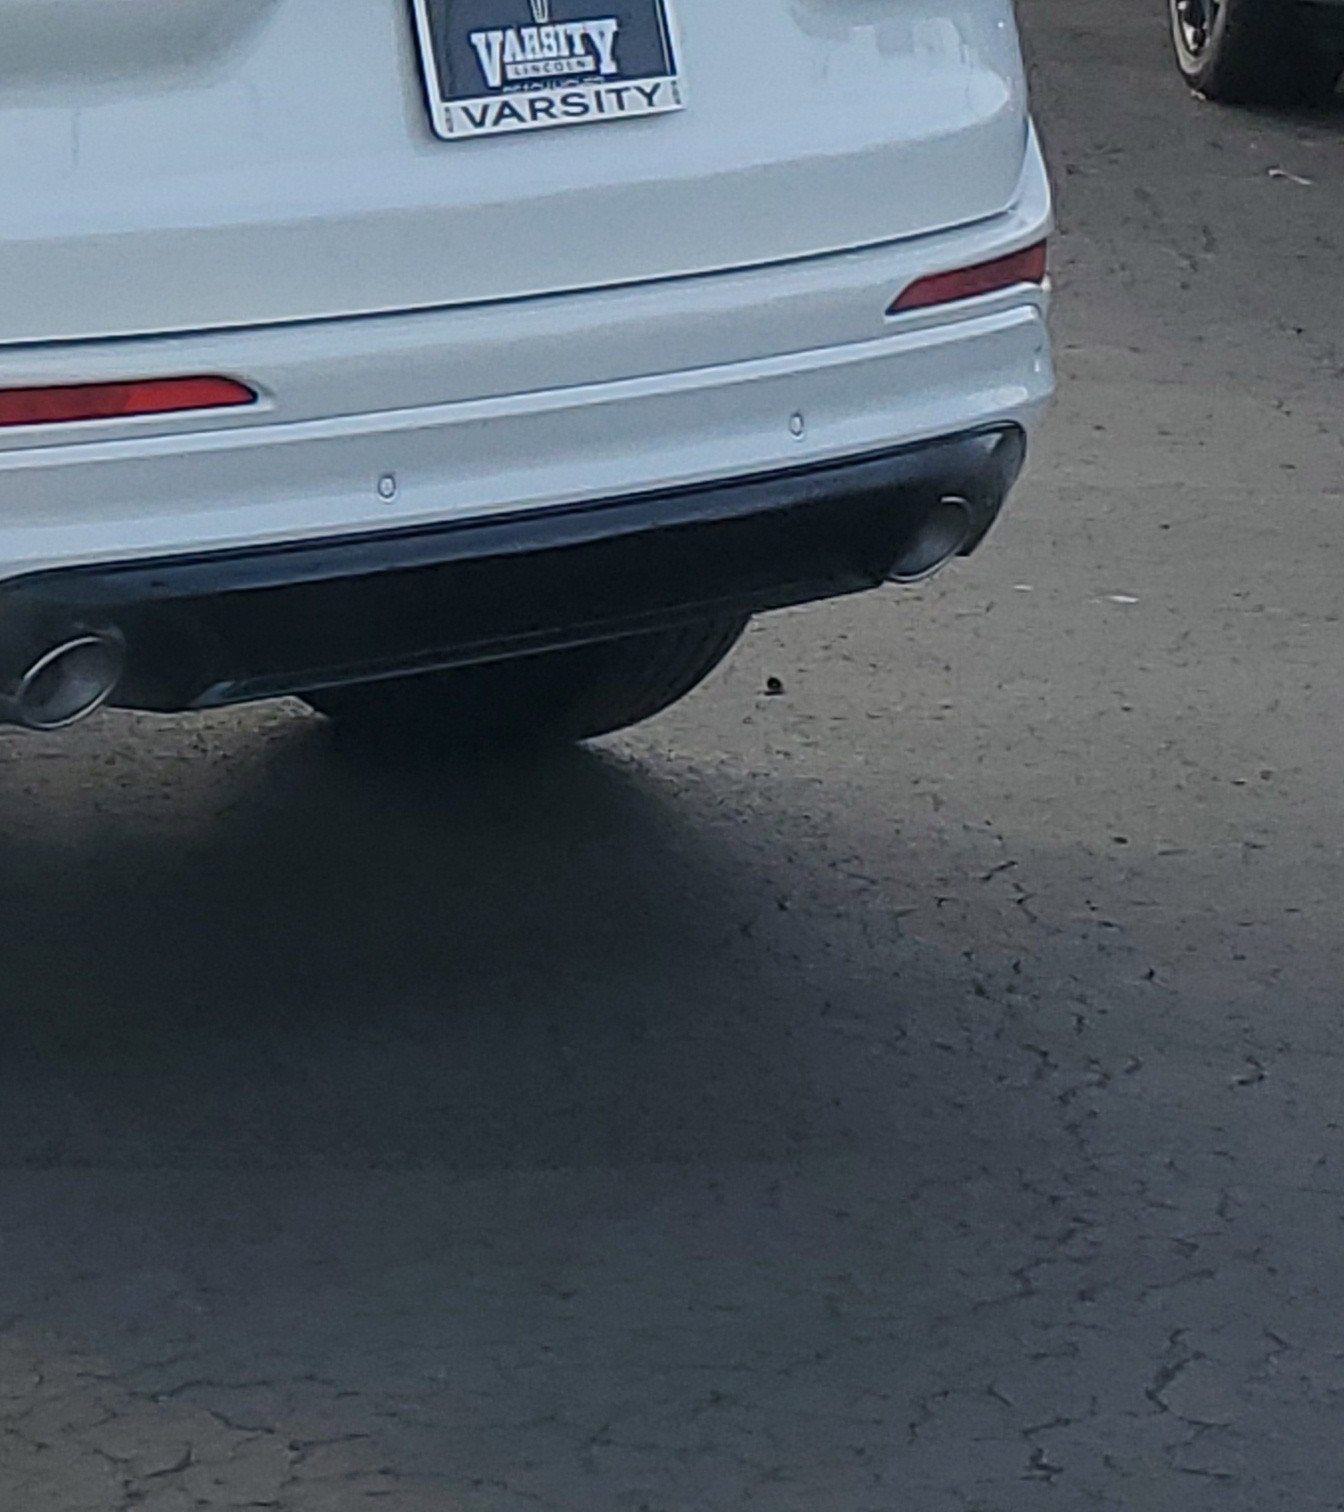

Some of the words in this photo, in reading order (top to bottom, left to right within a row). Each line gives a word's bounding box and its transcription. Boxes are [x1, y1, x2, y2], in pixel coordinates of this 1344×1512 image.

[469, 18, 619, 88] VARSITY
[513, 59, 589, 76] LINCOLN
[461, 82, 662, 128] VARSITY
